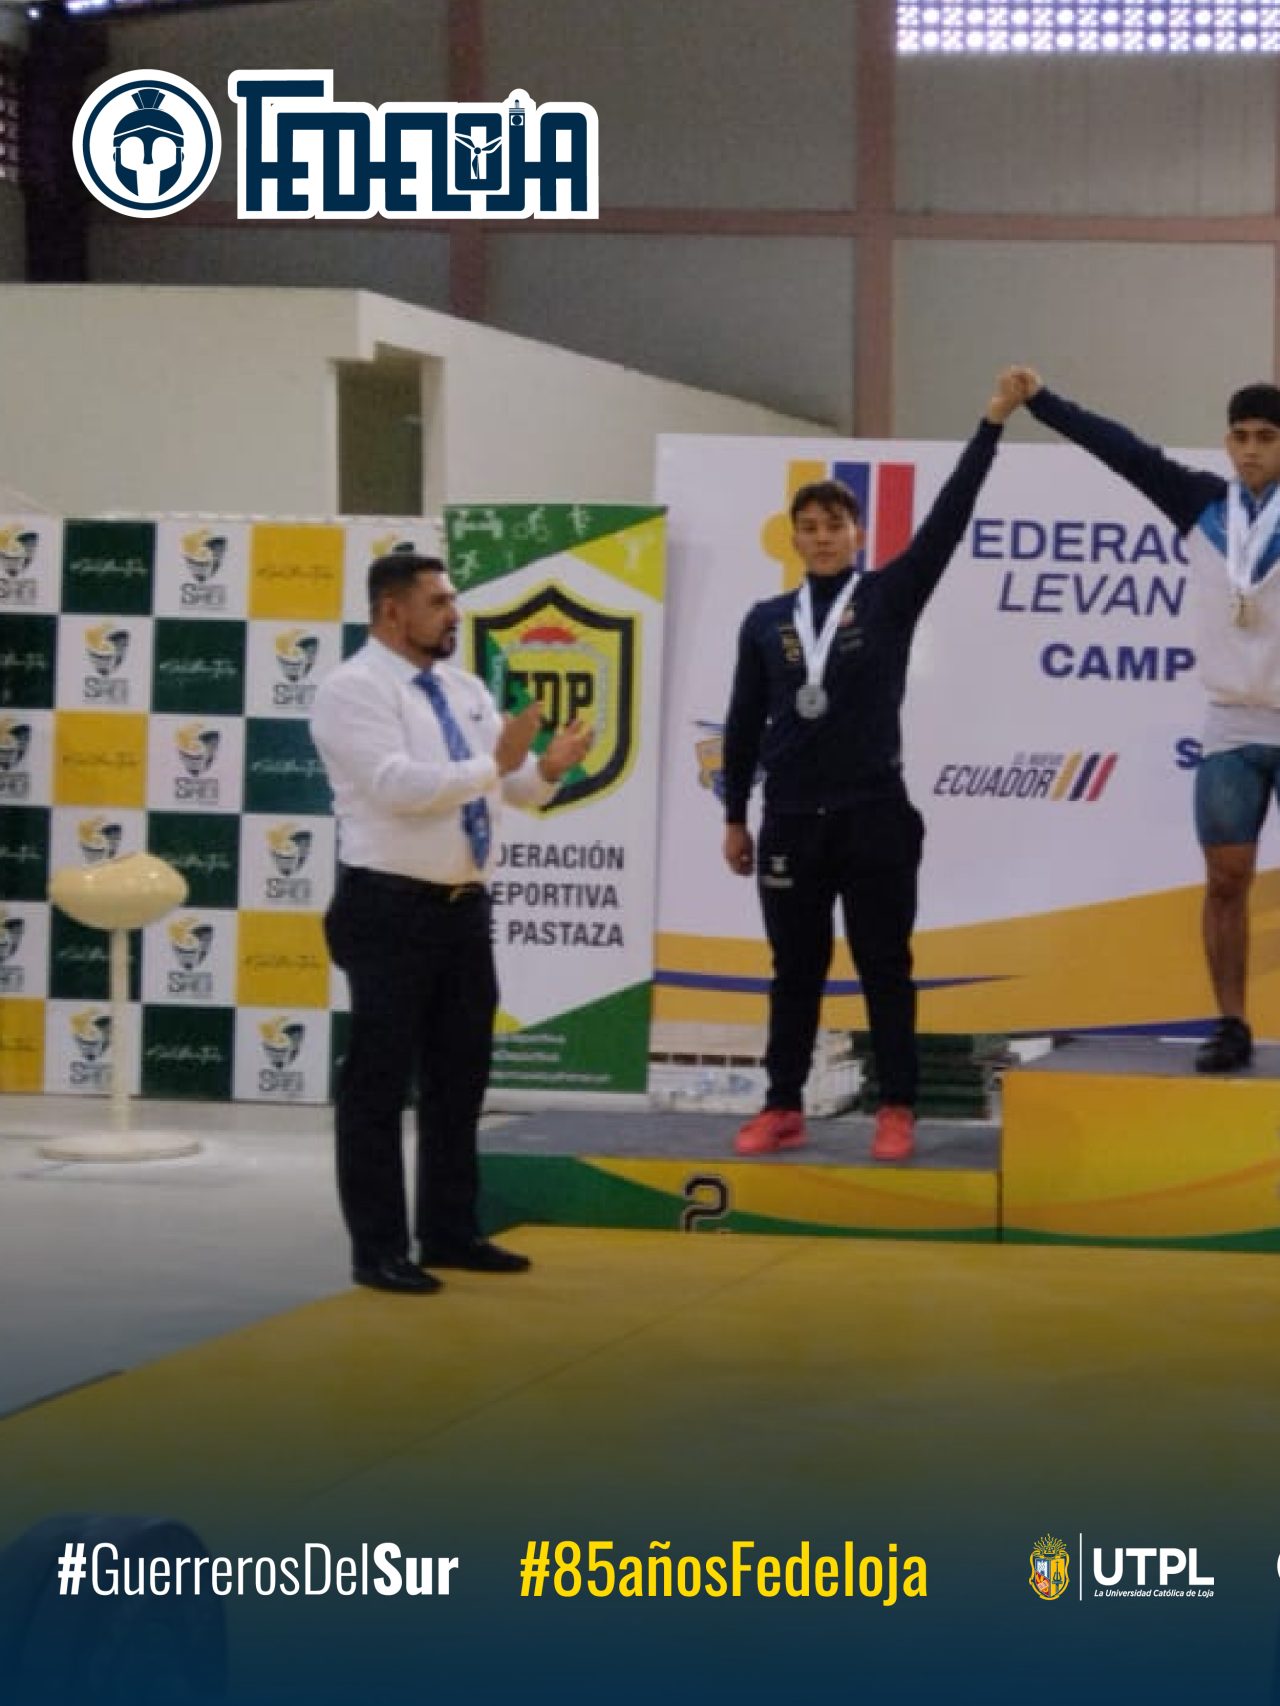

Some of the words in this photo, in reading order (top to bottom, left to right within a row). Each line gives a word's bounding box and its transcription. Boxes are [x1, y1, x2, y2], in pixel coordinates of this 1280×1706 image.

[972, 517, 1189, 566] EDERAC
[933, 763, 1057, 799] ECUADOR
[490, 881, 619, 909] EPORTIVA
[507, 921, 624, 948] PASTAZA
[682, 1176, 731, 1233] 2
